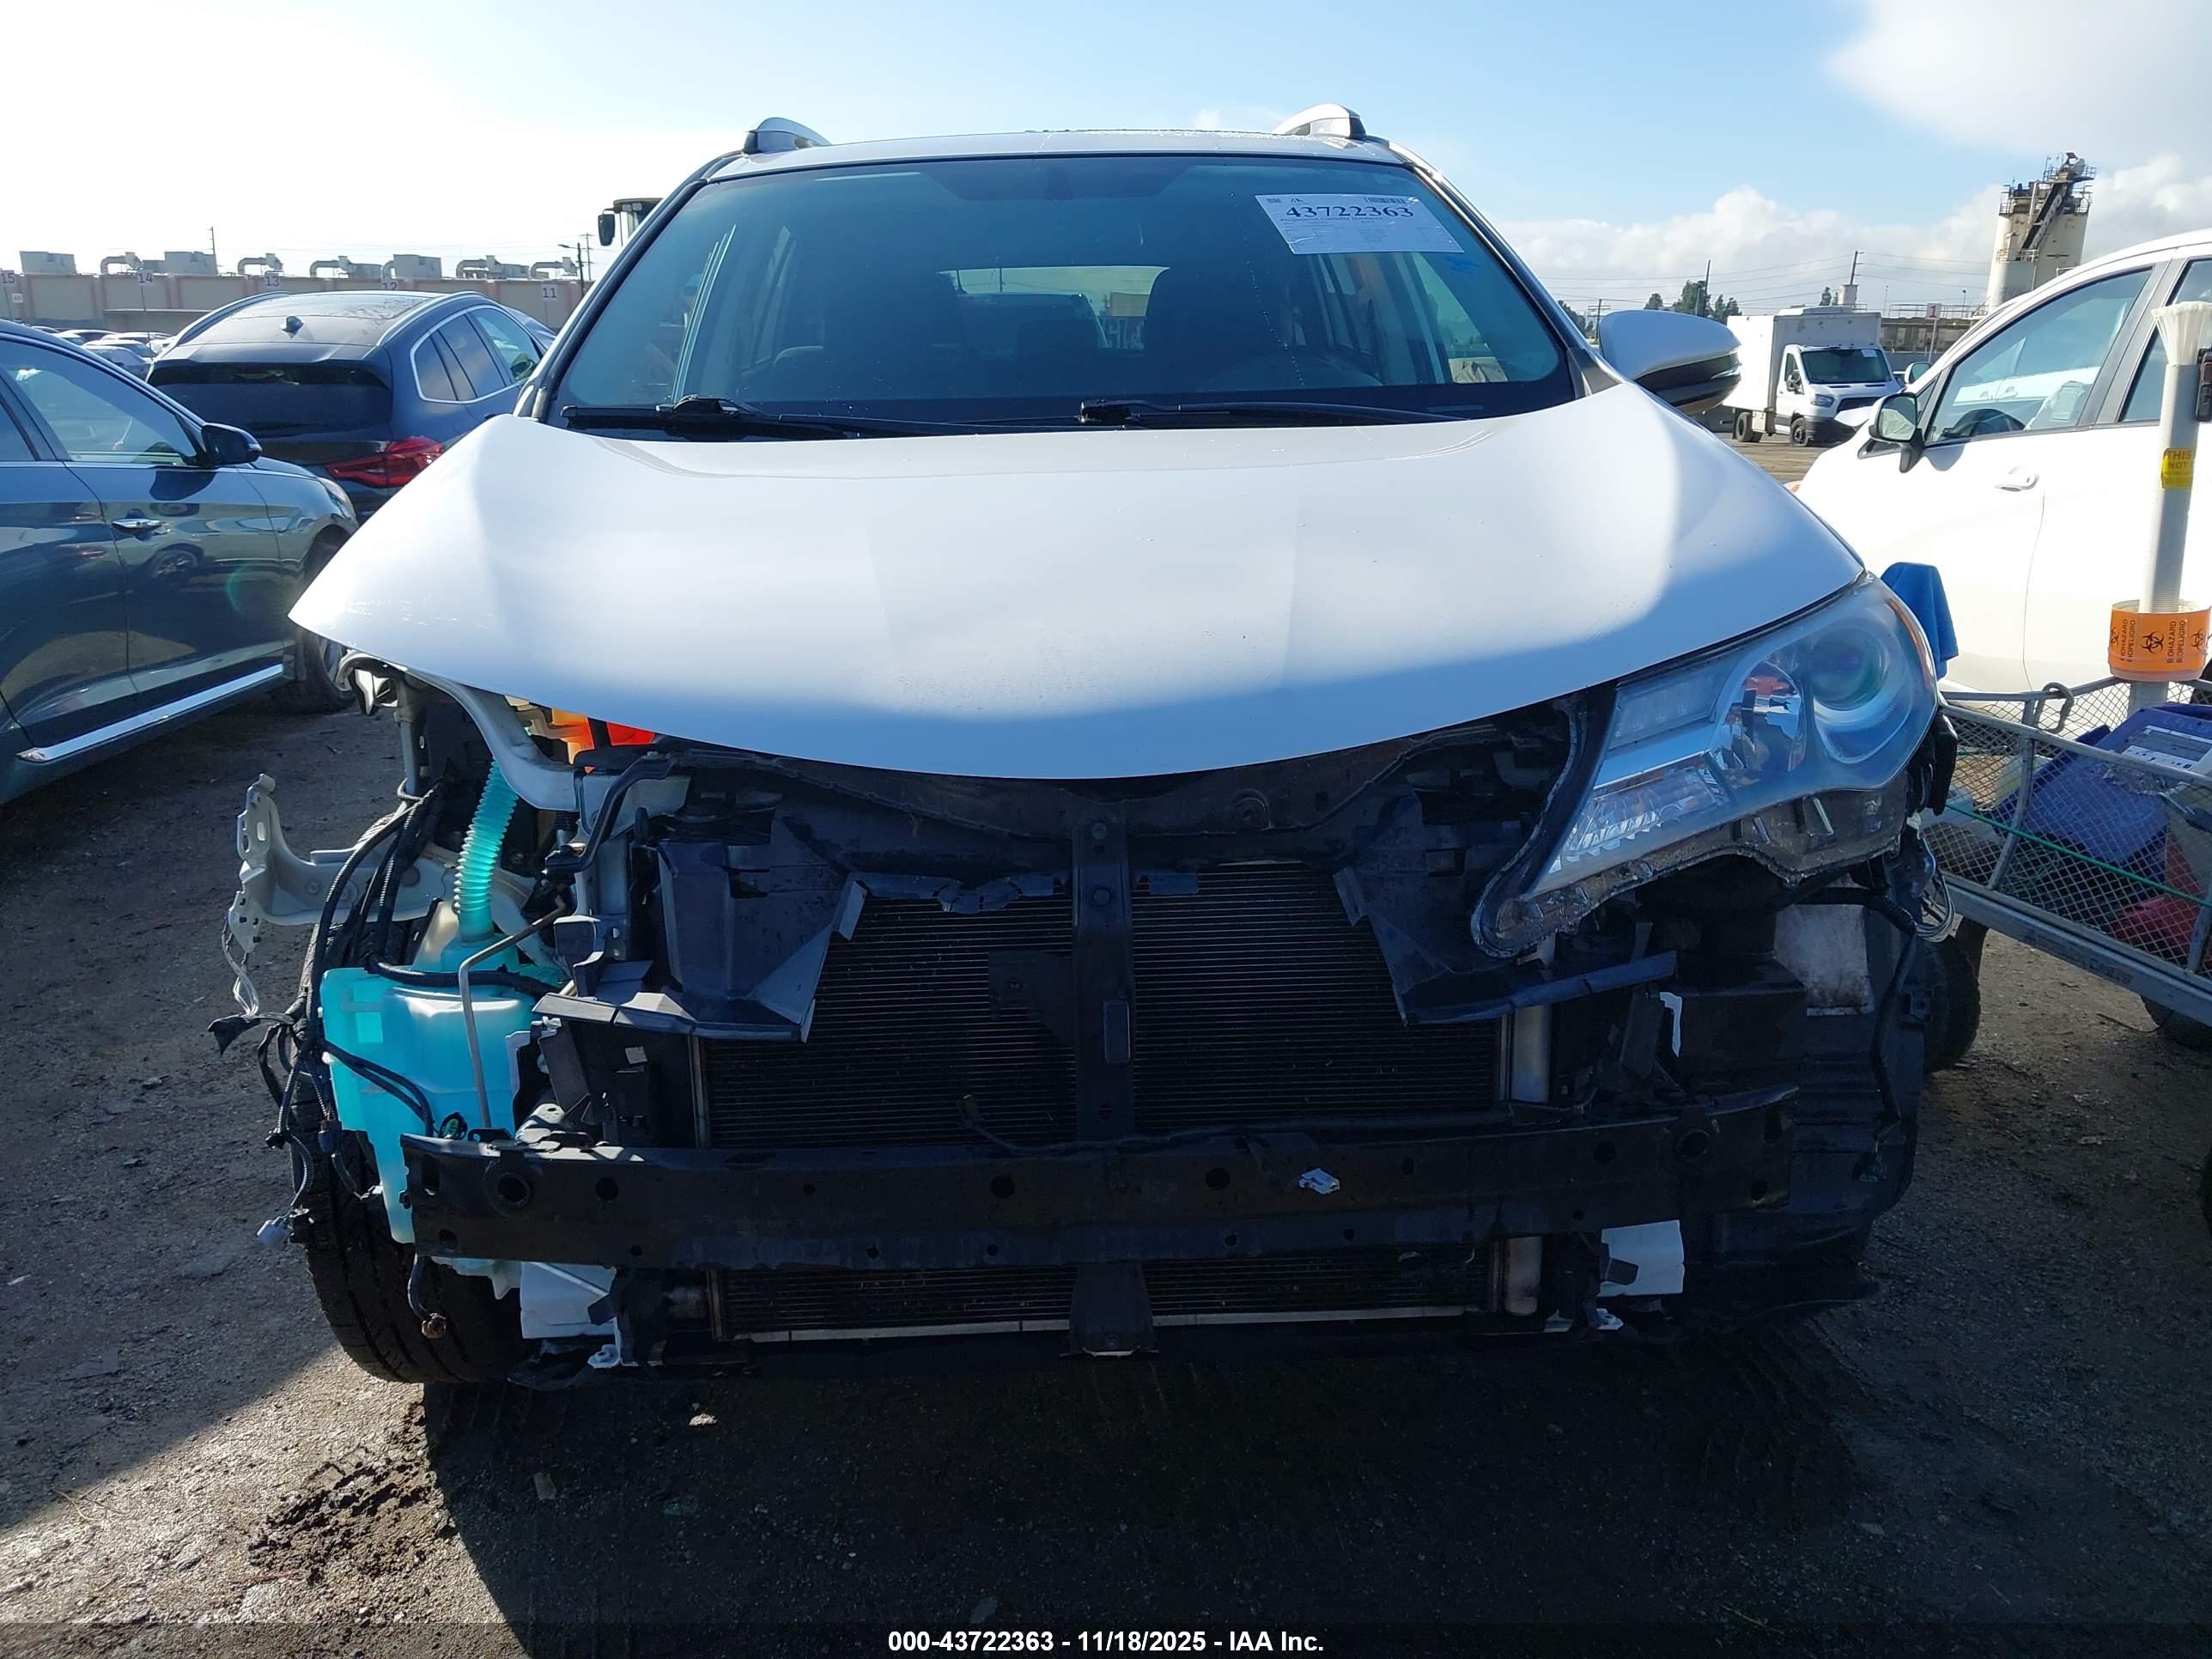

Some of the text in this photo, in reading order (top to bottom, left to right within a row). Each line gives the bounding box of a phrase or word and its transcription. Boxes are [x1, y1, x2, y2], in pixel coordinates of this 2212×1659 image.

[1285, 206, 1413, 218] 43722363
[2, 271, 15, 283] 15
[137, 271, 153, 283] 14
[265, 275, 280, 287] 13
[542, 288, 557, 298] 11
[1929, 305, 1937, 318] 1
